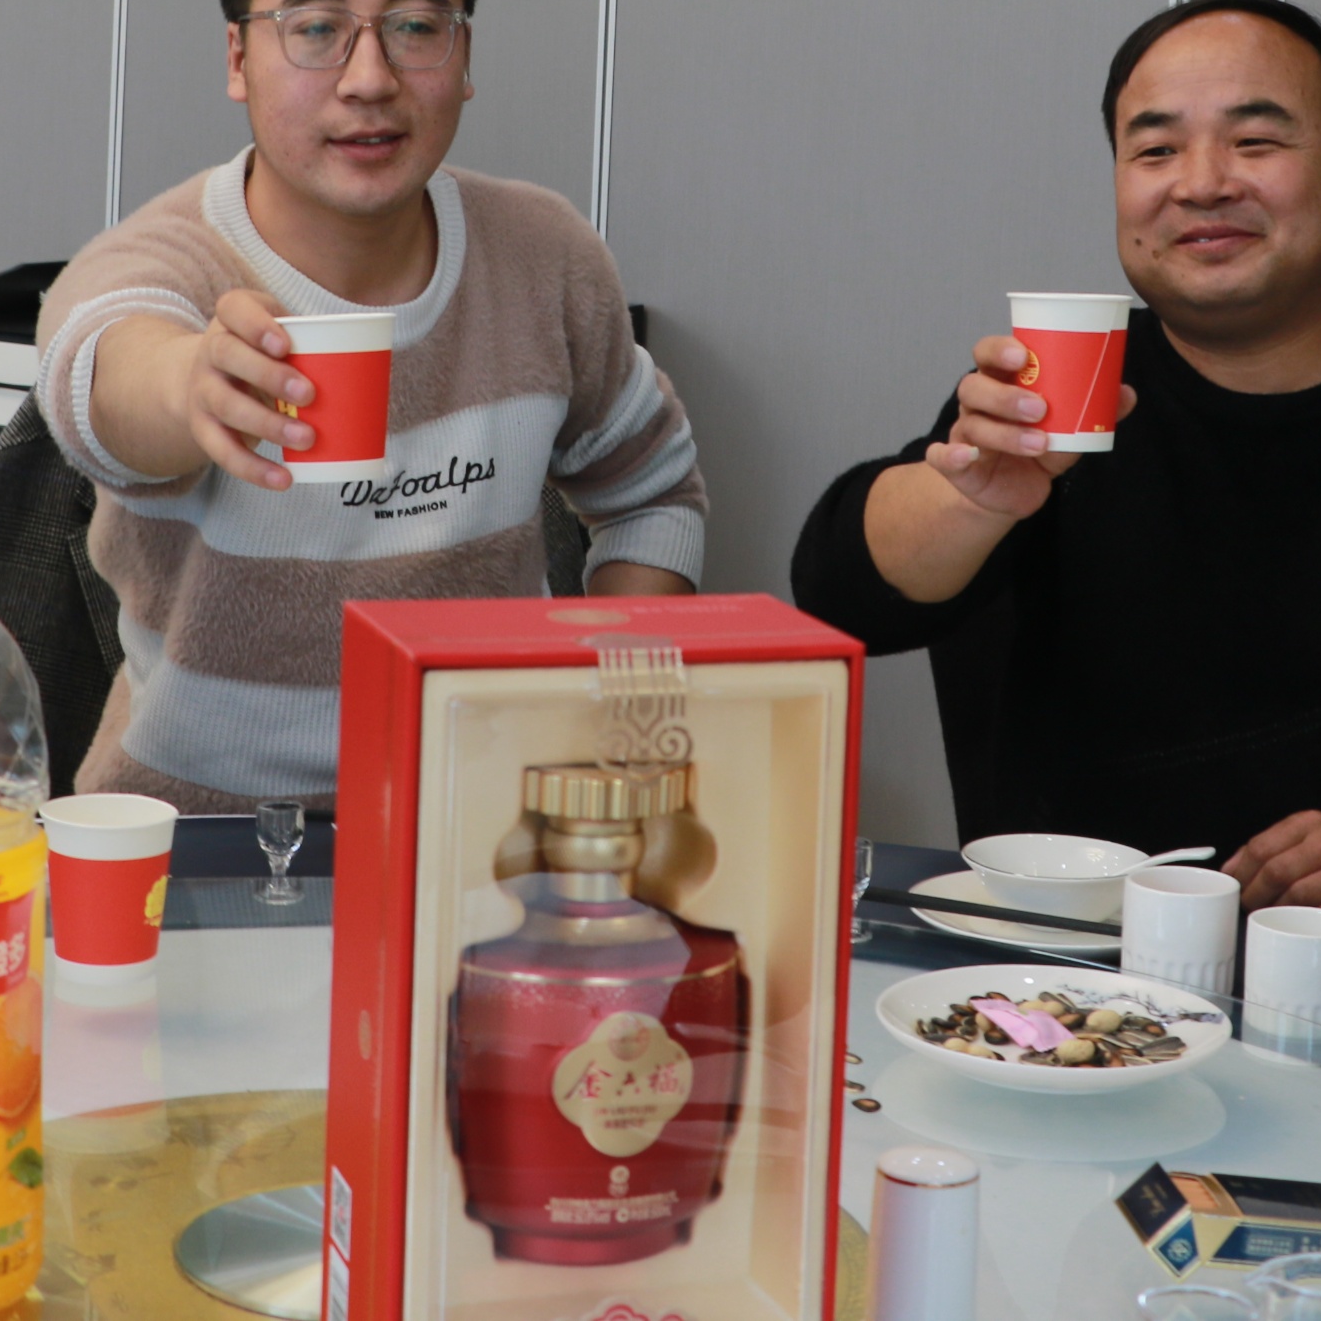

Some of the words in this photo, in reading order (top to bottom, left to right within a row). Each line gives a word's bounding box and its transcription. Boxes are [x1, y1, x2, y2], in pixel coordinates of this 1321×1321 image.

[397, 500, 448, 518] FASHION
[564, 1060, 677, 1098] 金六福
